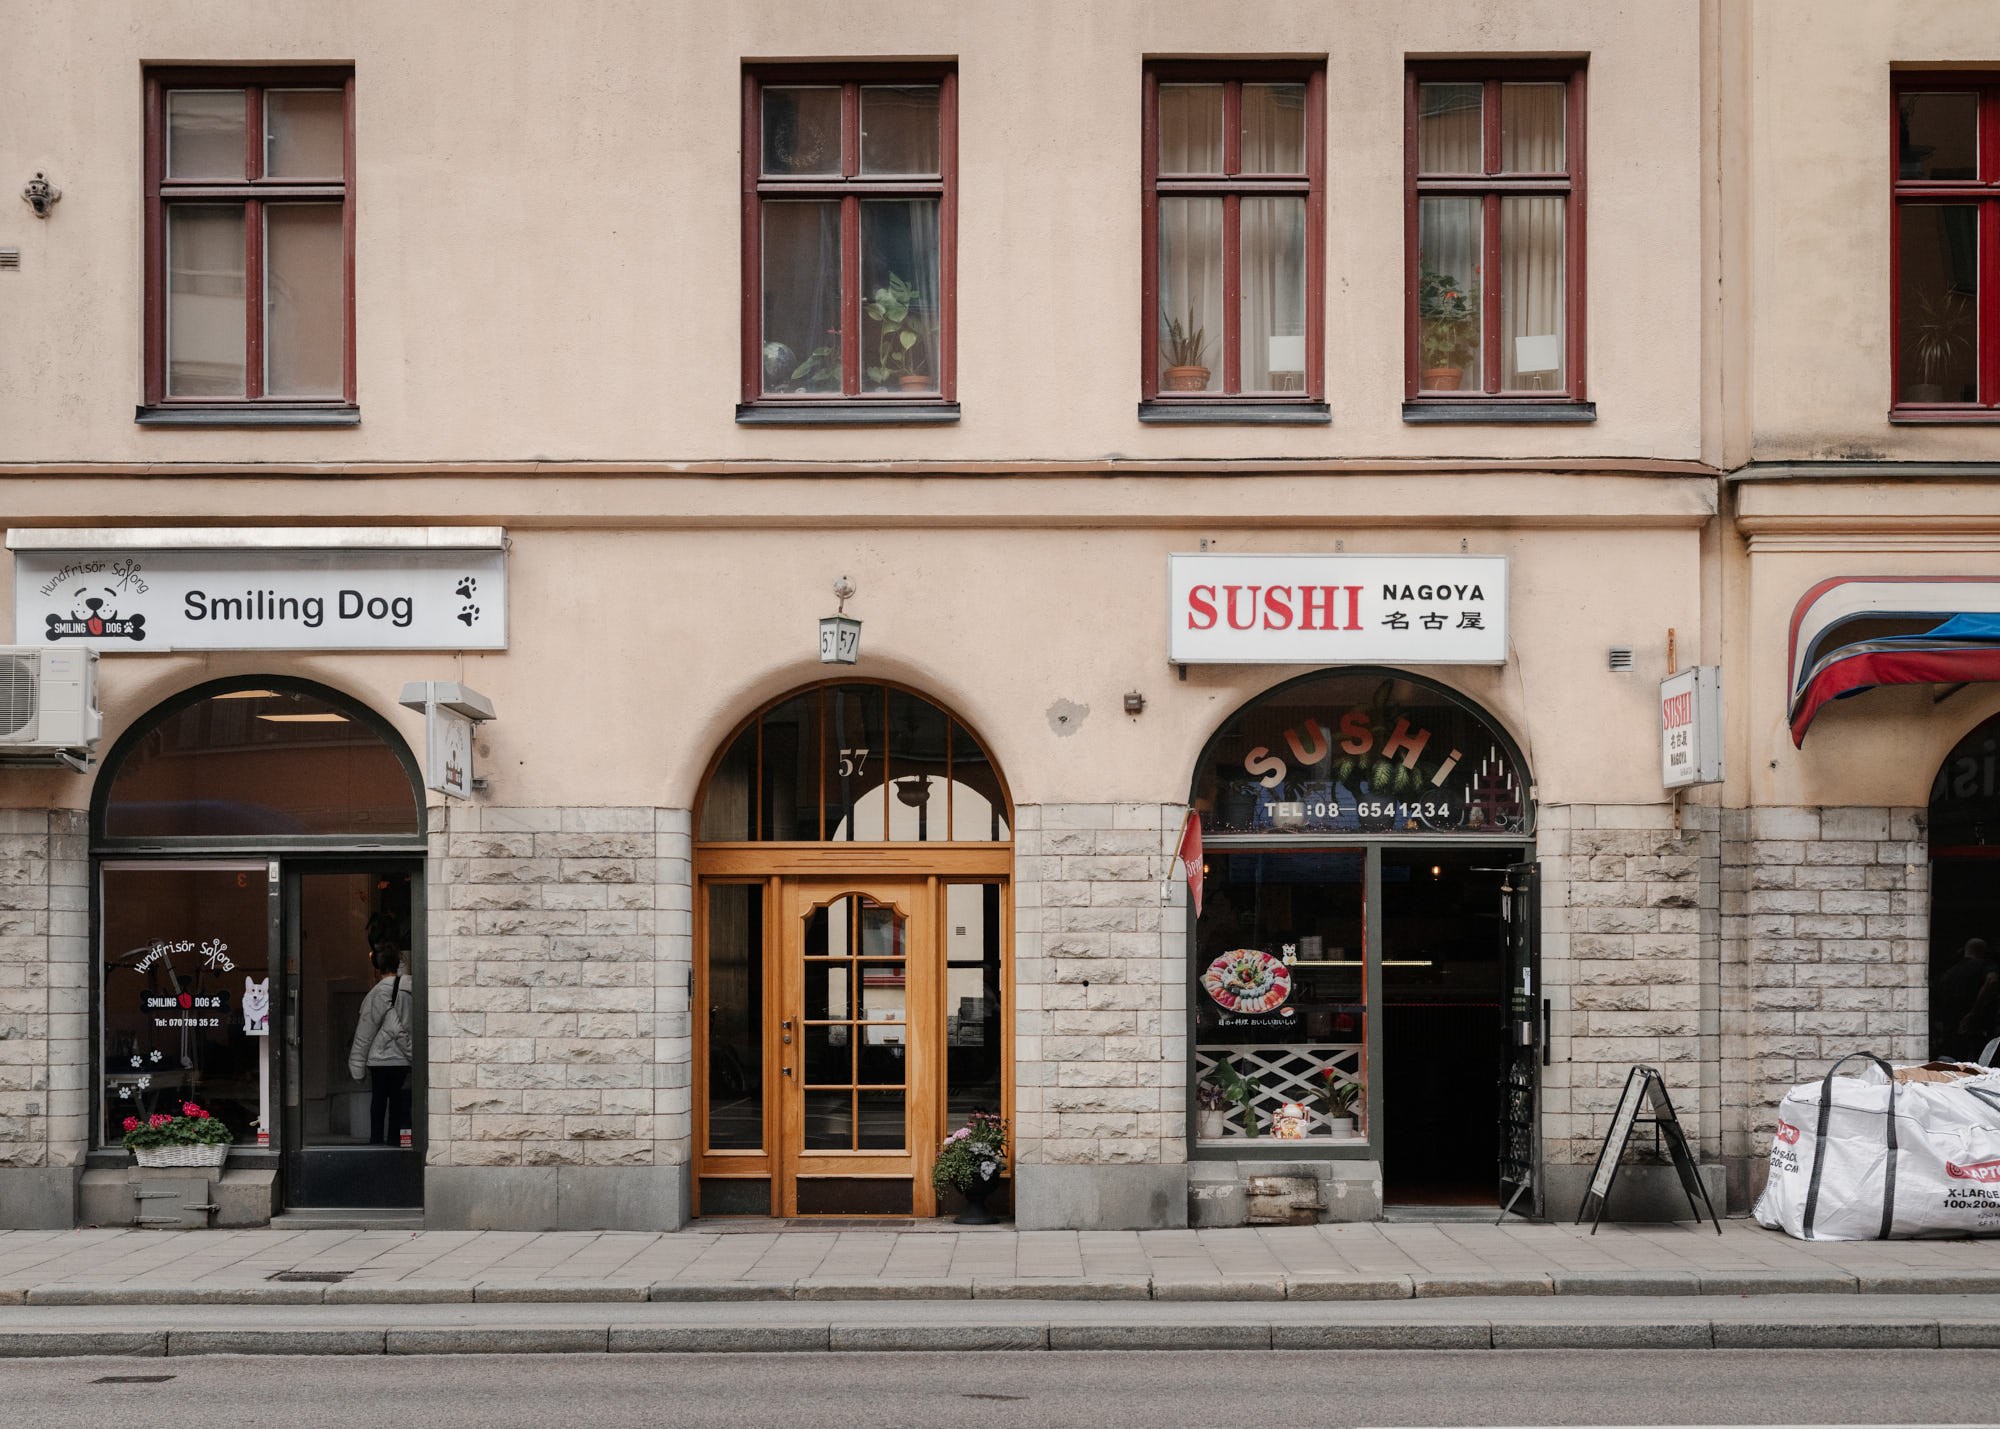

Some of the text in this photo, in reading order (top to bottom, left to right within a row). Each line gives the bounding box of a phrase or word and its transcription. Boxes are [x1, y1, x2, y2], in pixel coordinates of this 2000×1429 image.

[40, 560, 106, 597] Hundfrisör
[184, 590, 413, 628] Smiling Dog
[1188, 584, 1486, 631] SUSHI NAGOYA
[54, 623, 122, 634] SMILING DOG
[1381, 610, 1487, 631] 名古屋
[822, 631, 835, 654] 57
[840, 630, 856, 654] 57
[1663, 691, 1692, 731] SUSHI
[839, 748, 870, 777] 57
[1670, 751, 1688, 767] NAGOYA
[134, 940, 195, 974] Hundfrisör
[147, 997, 210, 1008] SMILING DOG
[154, 1018, 219, 1027] Tel: 070 789 35 22
